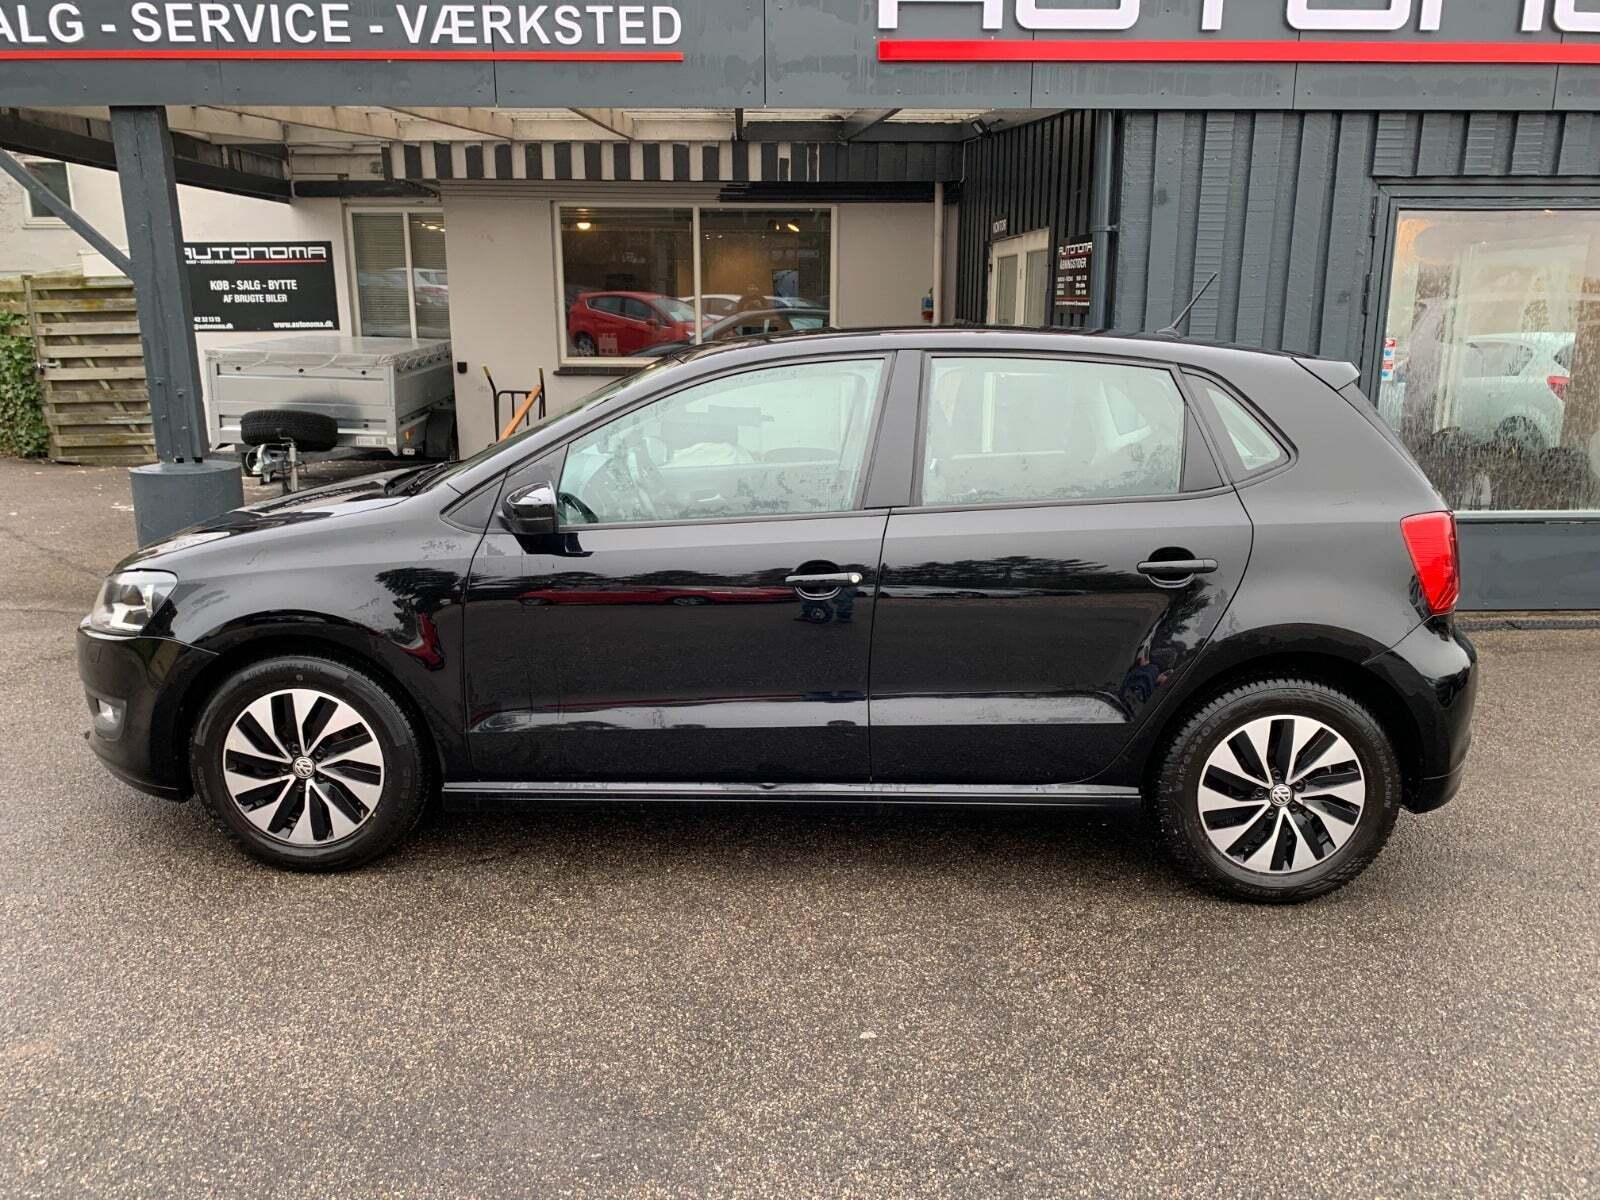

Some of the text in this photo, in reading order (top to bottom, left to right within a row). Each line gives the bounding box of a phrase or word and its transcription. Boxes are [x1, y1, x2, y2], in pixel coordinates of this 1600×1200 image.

[131, 3, 352, 45] SERVICE
[396, 4, 682, 46] VÆRKSTED
[210, 280, 230, 290] KØB
[237, 280, 261, 290] SALG
[268, 280, 298, 290] BYTTE
[223, 294, 288, 303] AF BRUGTE BILER
